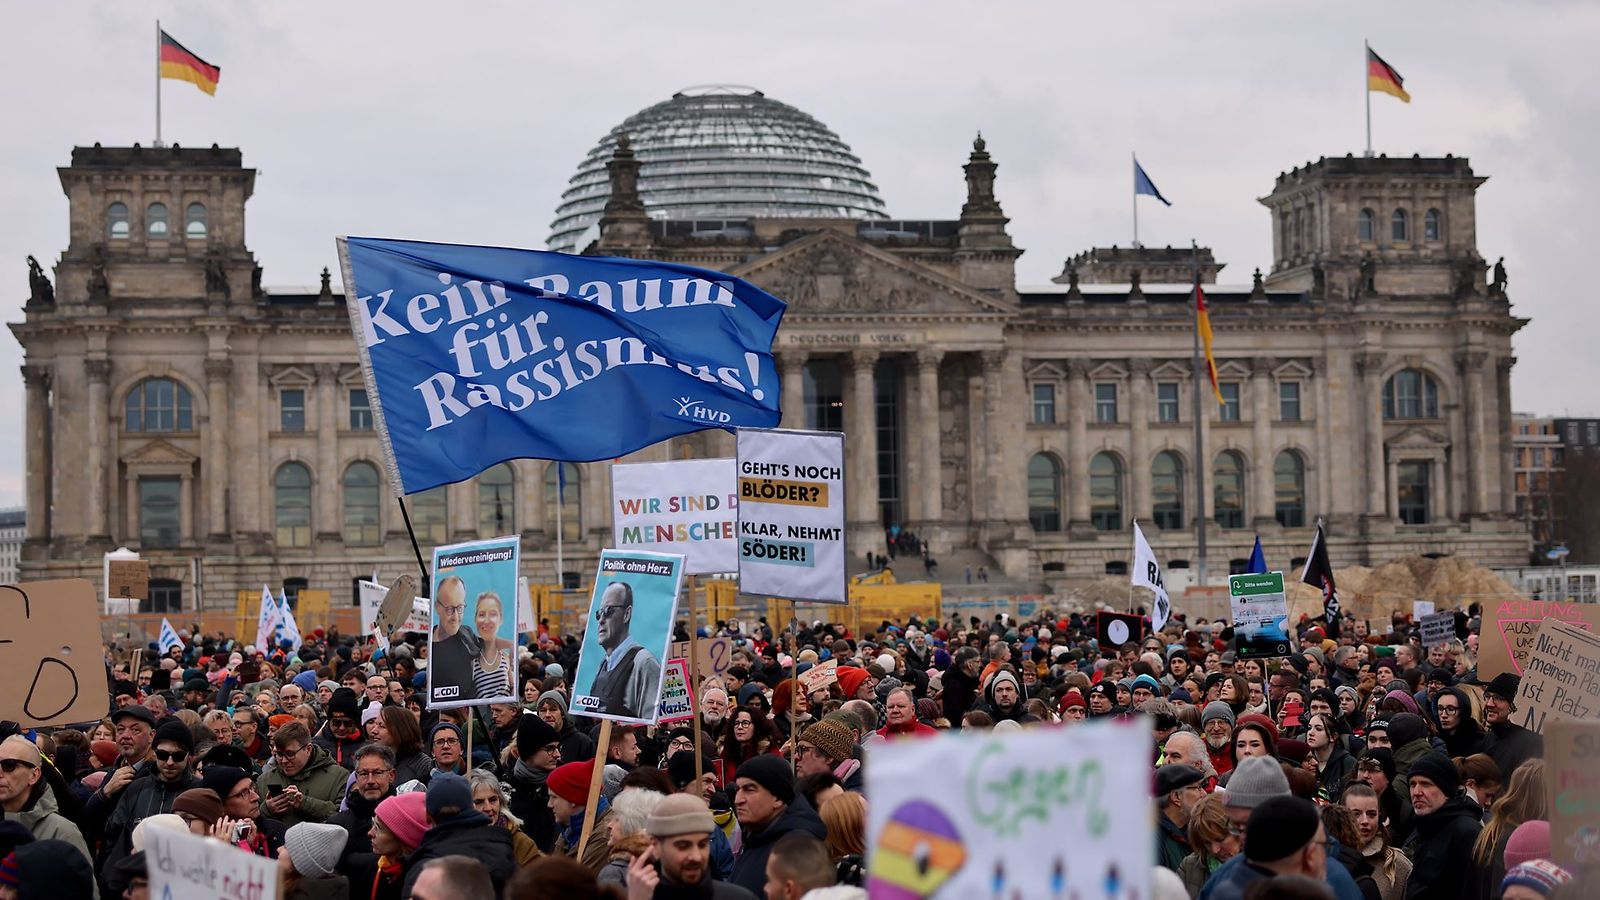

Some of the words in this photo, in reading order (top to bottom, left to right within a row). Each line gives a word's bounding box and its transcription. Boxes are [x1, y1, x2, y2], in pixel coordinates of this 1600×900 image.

[358, 273, 511, 347] Kein
[524, 274, 736, 313] Raum
[449, 310, 549, 378] für
[694, 407, 731, 422] HVD
[742, 461, 789, 477] GEHT'S
[795, 465, 841, 480] NOCH
[742, 479, 820, 502] BLÖDER?
[620, 498, 661, 515] WIR
[669, 494, 720, 513] SIND
[742, 521, 782, 539] KLAR,
[788, 525, 841, 541] NEHMT
[440, 549, 512, 567] Wiedervereinigung!
[742, 538, 806, 562] SÖDER!
[604, 559, 626, 571] Politik
[627, 561, 647, 572] ohne
[646, 562, 671, 574] Herz.
[1535, 633, 1573, 662] Nicht
[1529, 656, 1577, 687] meinem
[441, 687, 458, 697] CDU
[581, 697, 599, 706] CDU
[1522, 675, 1544, 703] ist
[1550, 686, 1589, 719] Platz
[658, 697, 692, 716] Nazis!
[967, 742, 1111, 839] Gegen
[222, 863, 265, 900] nicht
